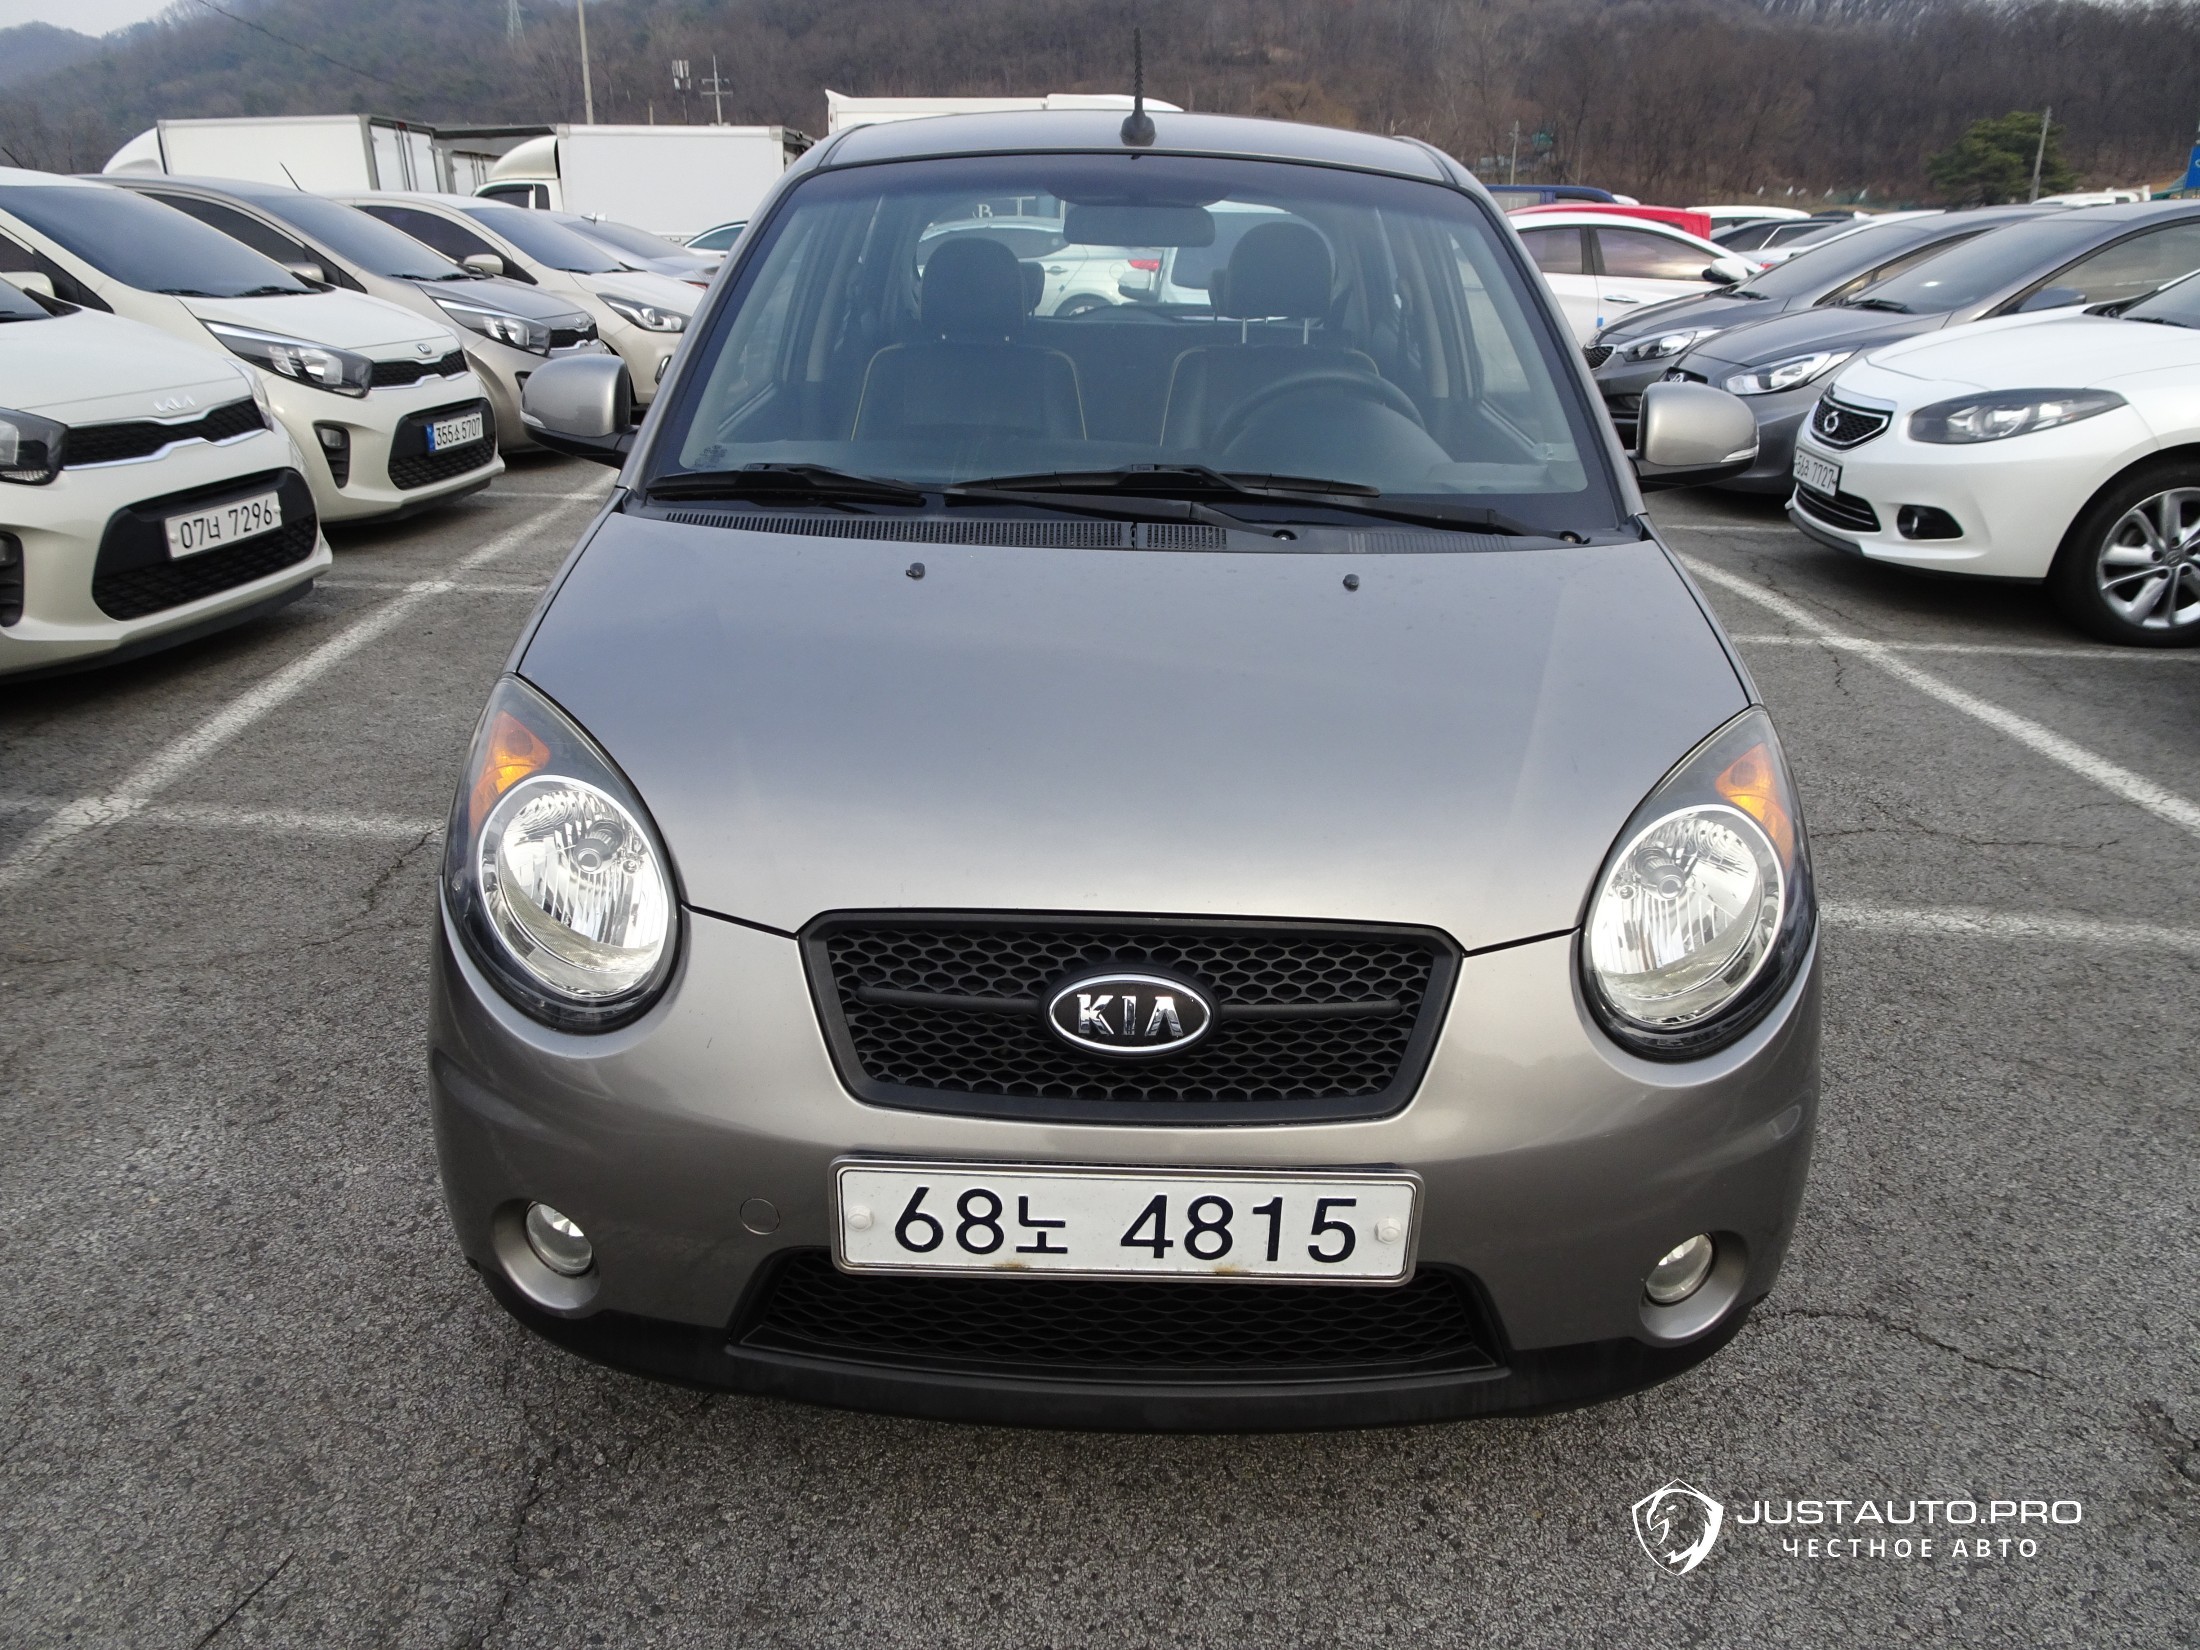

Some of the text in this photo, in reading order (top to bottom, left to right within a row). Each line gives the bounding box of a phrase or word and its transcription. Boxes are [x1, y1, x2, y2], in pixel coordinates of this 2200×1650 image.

[1811, 461, 1835, 489] 7727
[181, 499, 273, 549] 07너 7296
[1077, 994, 1184, 1037] KIA
[894, 1186, 1358, 1264] 68노 4815
